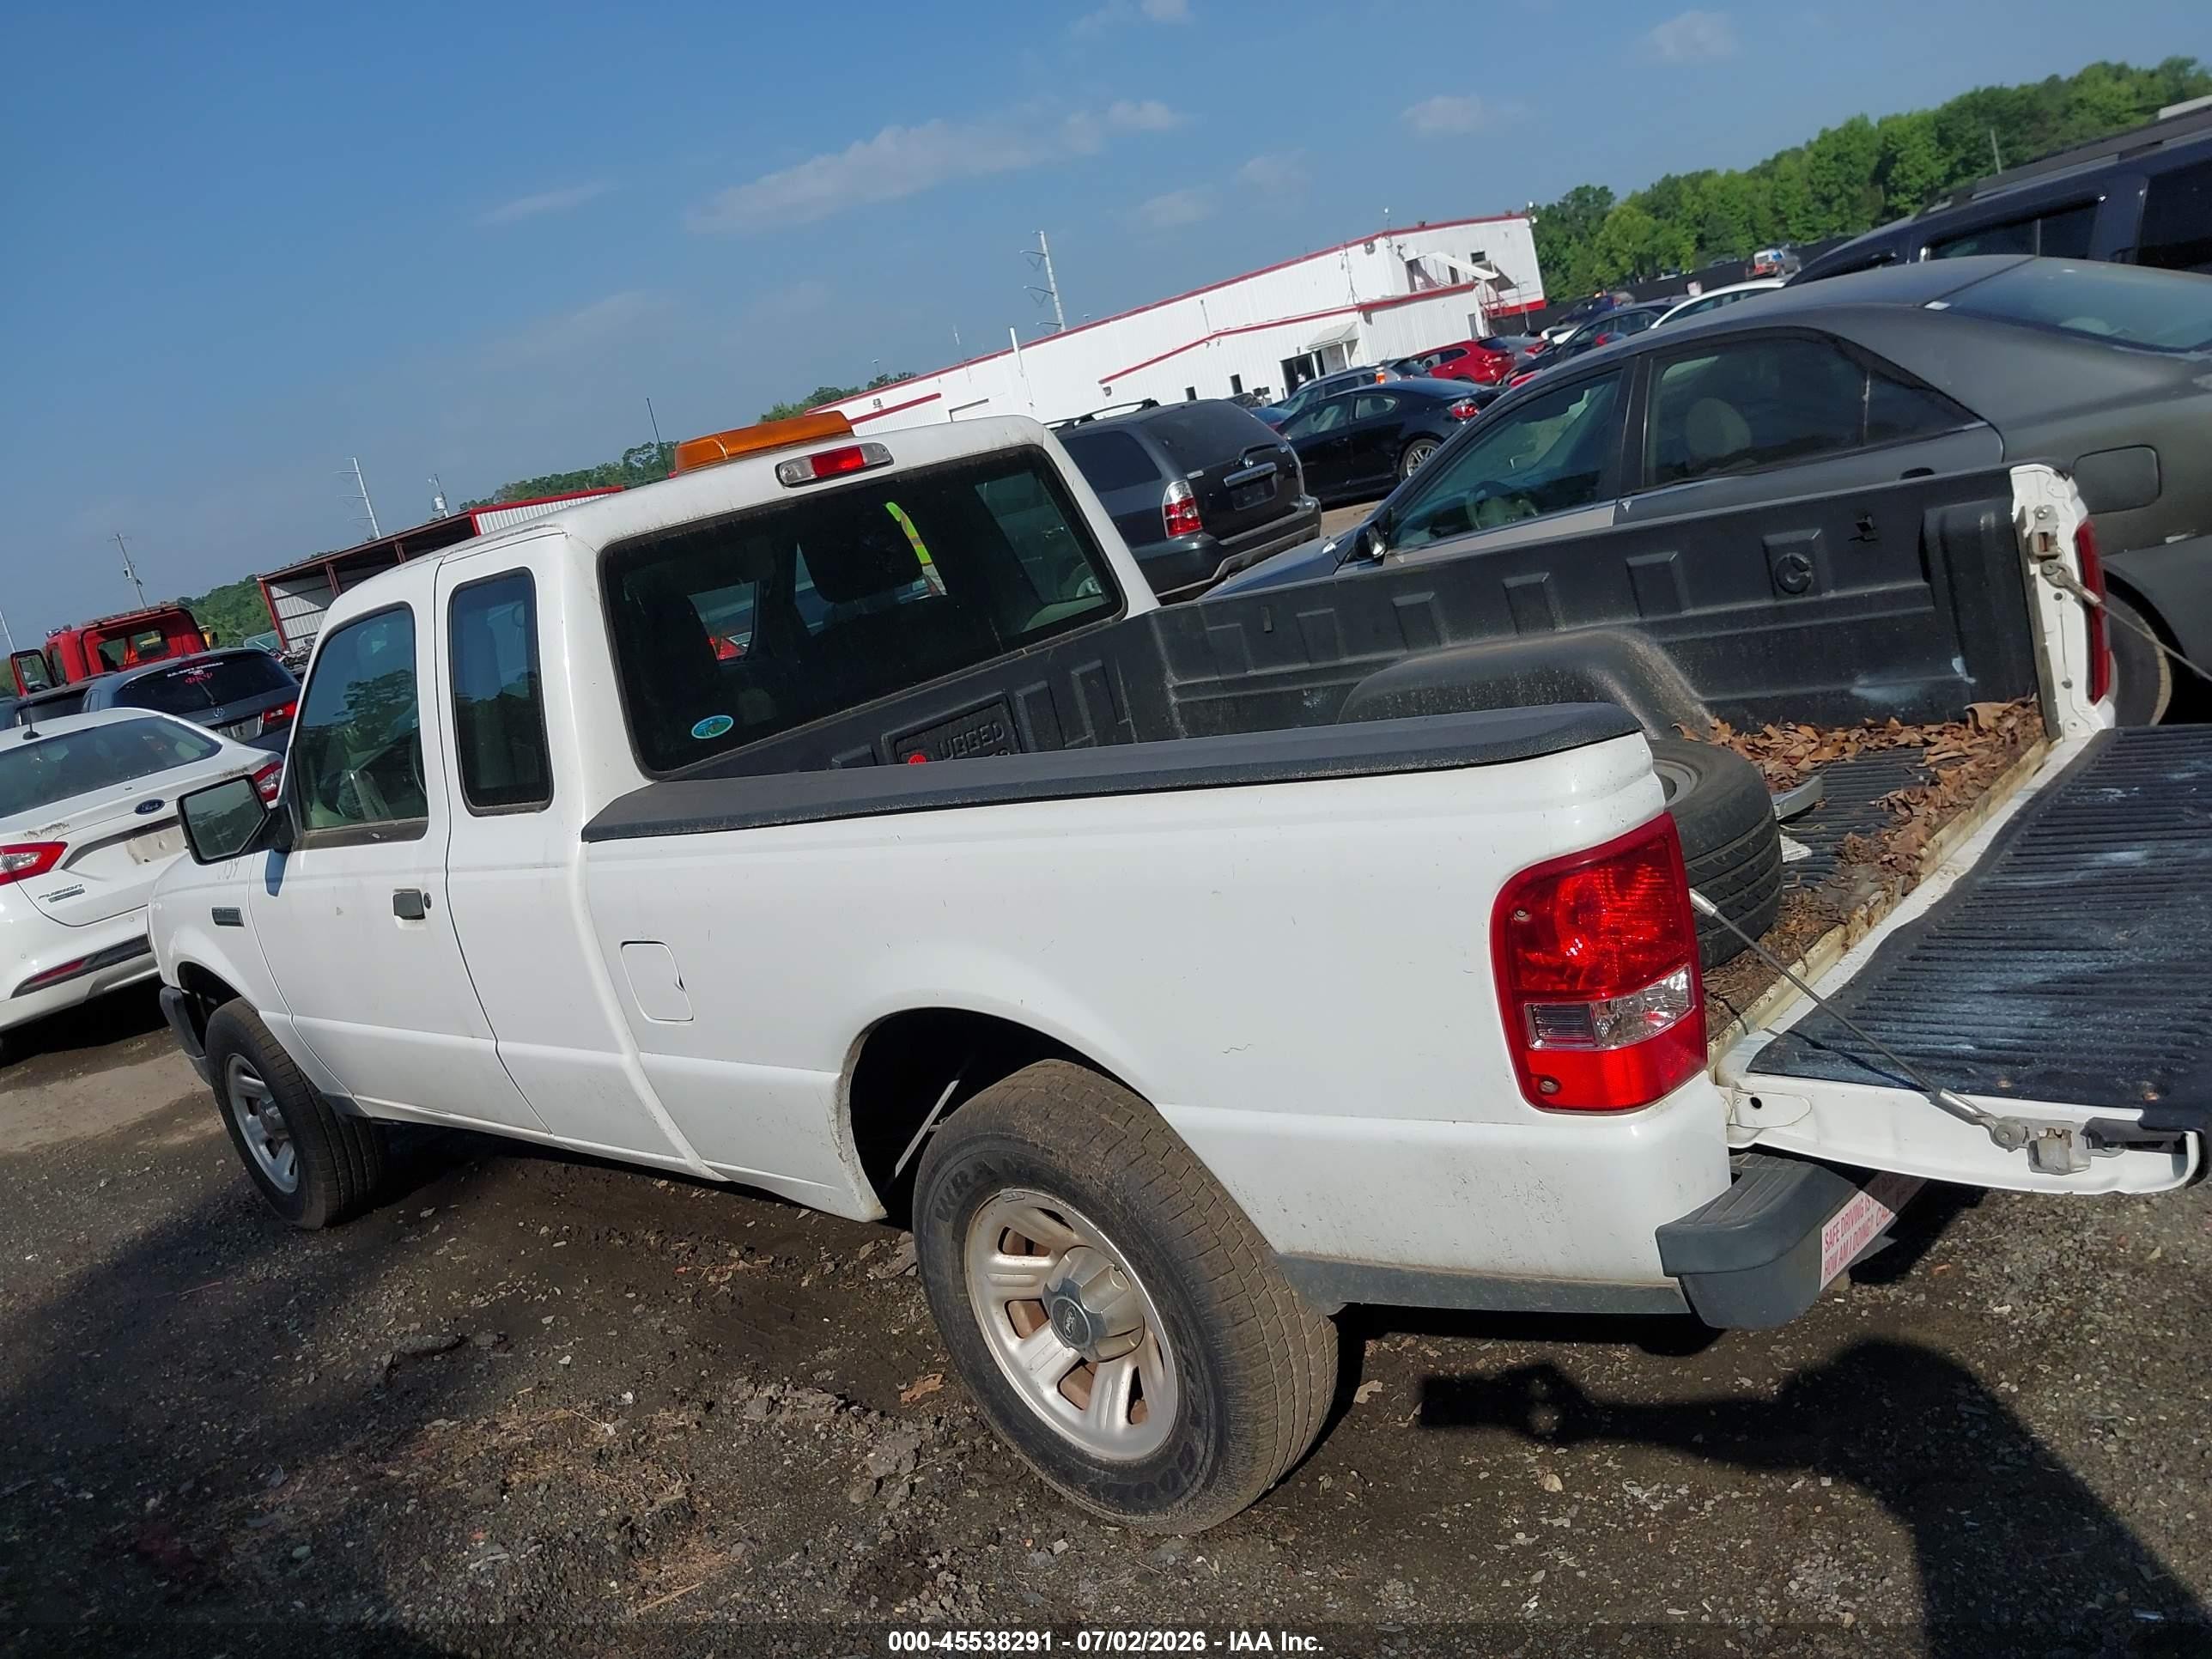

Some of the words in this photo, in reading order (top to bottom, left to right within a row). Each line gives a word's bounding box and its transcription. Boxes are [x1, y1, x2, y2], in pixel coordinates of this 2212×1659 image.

[1824, 1222, 1839, 1253] SAFE
[1841, 1198, 1863, 1237] DRIVING
[1824, 1250, 1838, 1279] HOW
